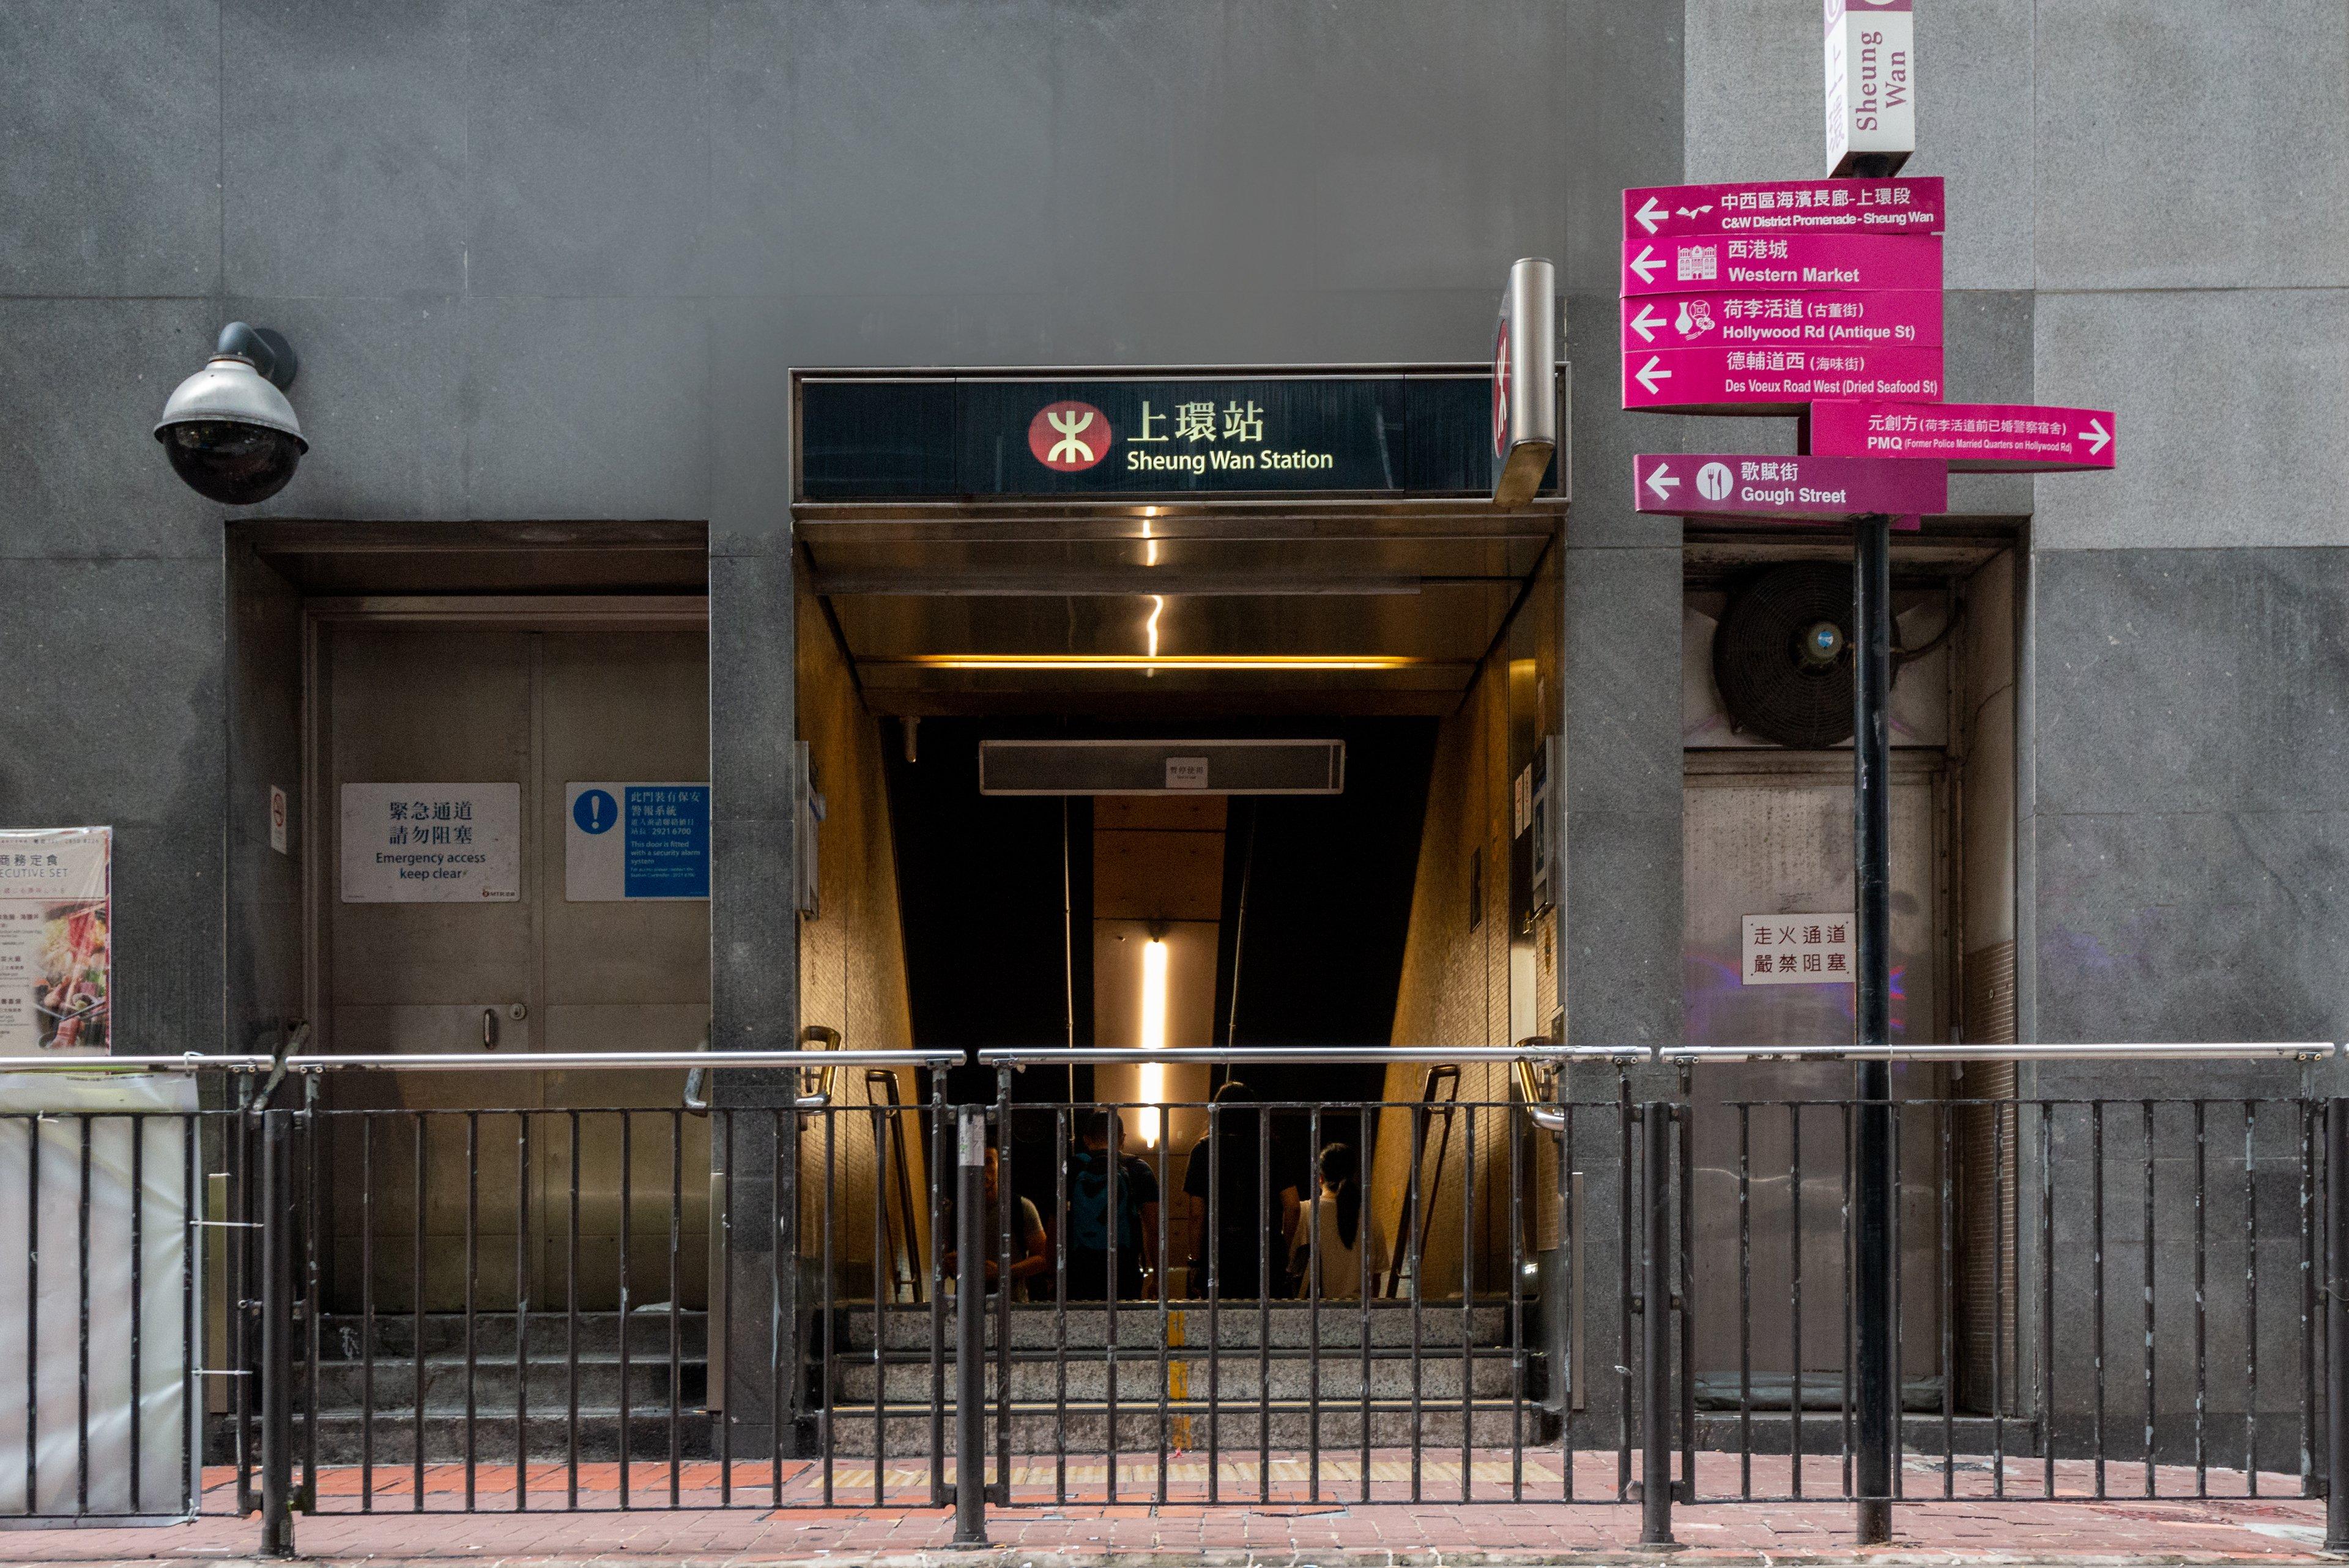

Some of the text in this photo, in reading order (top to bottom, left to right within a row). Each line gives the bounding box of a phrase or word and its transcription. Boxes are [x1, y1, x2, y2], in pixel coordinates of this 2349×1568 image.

[1855, 31, 1883, 131] Sheung
[1885, 51, 1907, 108] Wan
[1721, 187, 1910, 210] 中西區海濱長廊-上環段
[1722, 216, 1751, 229] C&W
[1753, 215, 1791, 228] District
[1793, 214, 1857, 226] Promenade
[1863, 212, 1906, 226] Sheung
[1908, 211, 1934, 223] Wan
[1728, 239, 1789, 259] 西港城
[1729, 267, 1859, 283] Western Market
[1723, 299, 1803, 319] 荷李活道
[1723, 325, 1915, 341] Hollywood Rd (Antique St)
[1727, 351, 1805, 371] 德輔道西
[1726, 379, 1938, 396] Des Voeux Road West (Dried Seafood St)
[1127, 400, 1264, 443] 上環站
[1868, 437, 1902, 450] PMQ
[1905, 438, 1932, 450] (Former
[1934, 439, 1954, 448] Police
[1956, 439, 1983, 448] Married
[1984, 439, 2013, 449] Quarters
[2025, 440, 2059, 453] Hollywood
[2060, 442, 2072, 454] Rd)
[1127, 450, 1334, 475] Sheung Wan Station
[1741, 462, 1798, 481] 歌賦街
[1742, 487, 1846, 505] Gough Street
[388, 801, 473, 821] 緊急通道
[388, 826, 473, 845] 請勿阻塞
[376, 853, 486, 866] Emergency access
[50, 869, 68, 877] SET
[400, 868, 462, 881] keep clear
[1754, 925, 1846, 946] 走火通道
[1754, 953, 1847, 974] 嚴禁阻塞
